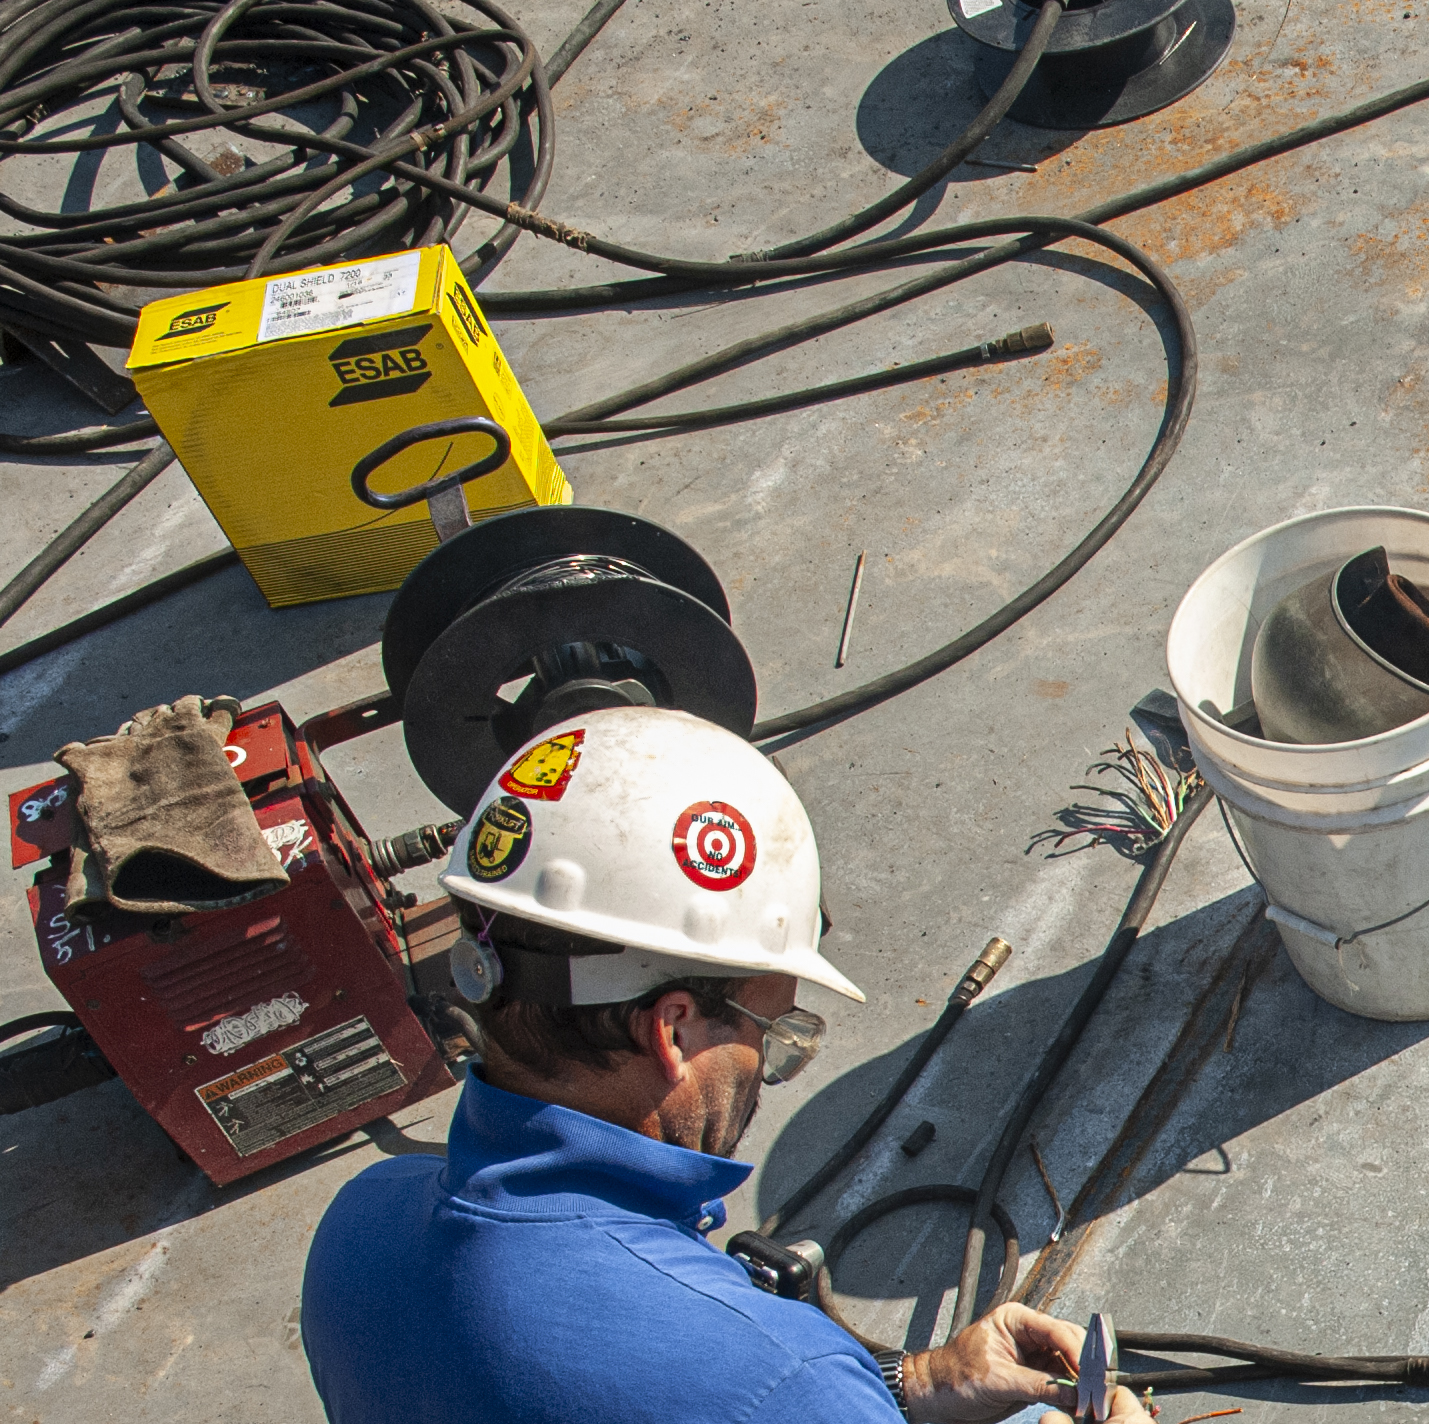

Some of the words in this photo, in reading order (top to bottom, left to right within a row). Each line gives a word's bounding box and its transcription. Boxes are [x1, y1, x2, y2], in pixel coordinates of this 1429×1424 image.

[272, 280, 298, 295] DUAL
[300, 272, 335, 289] SHIELD
[340, 268, 361, 282] 7200
[169, 312, 217, 331] ESAB
[332, 348, 428, 385] ESAB
[691, 813, 714, 825] OUR
[707, 850, 723, 861] NO
[214, 1060, 284, 1092] WARNING
